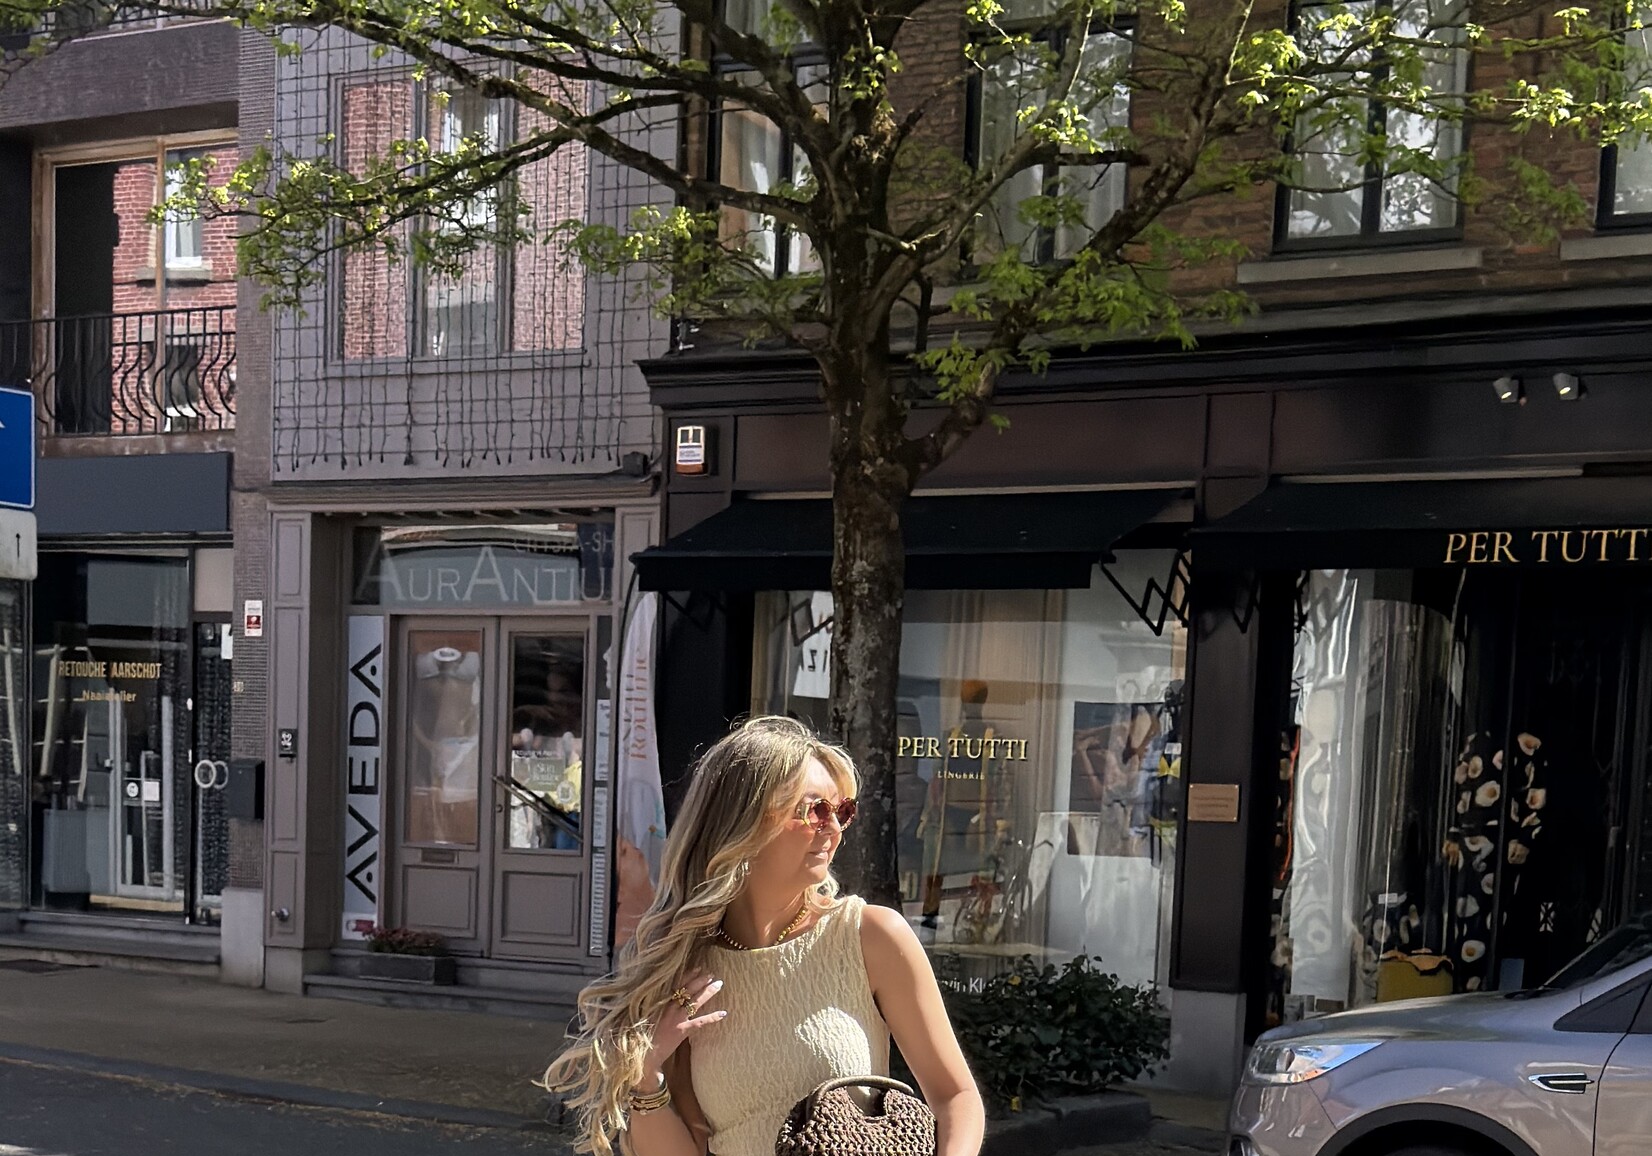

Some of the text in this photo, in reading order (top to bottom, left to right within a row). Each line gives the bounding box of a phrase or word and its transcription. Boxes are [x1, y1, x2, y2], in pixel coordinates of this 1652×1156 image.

[1443, 528, 1652, 564] PER TUTT
[59, 661, 162, 679] RETOUCHE AARSCHOT
[897, 736, 1029, 760] PER TUTTI
[346, 643, 382, 904] AVEDA
[937, 770, 985, 780] LINGERIE
